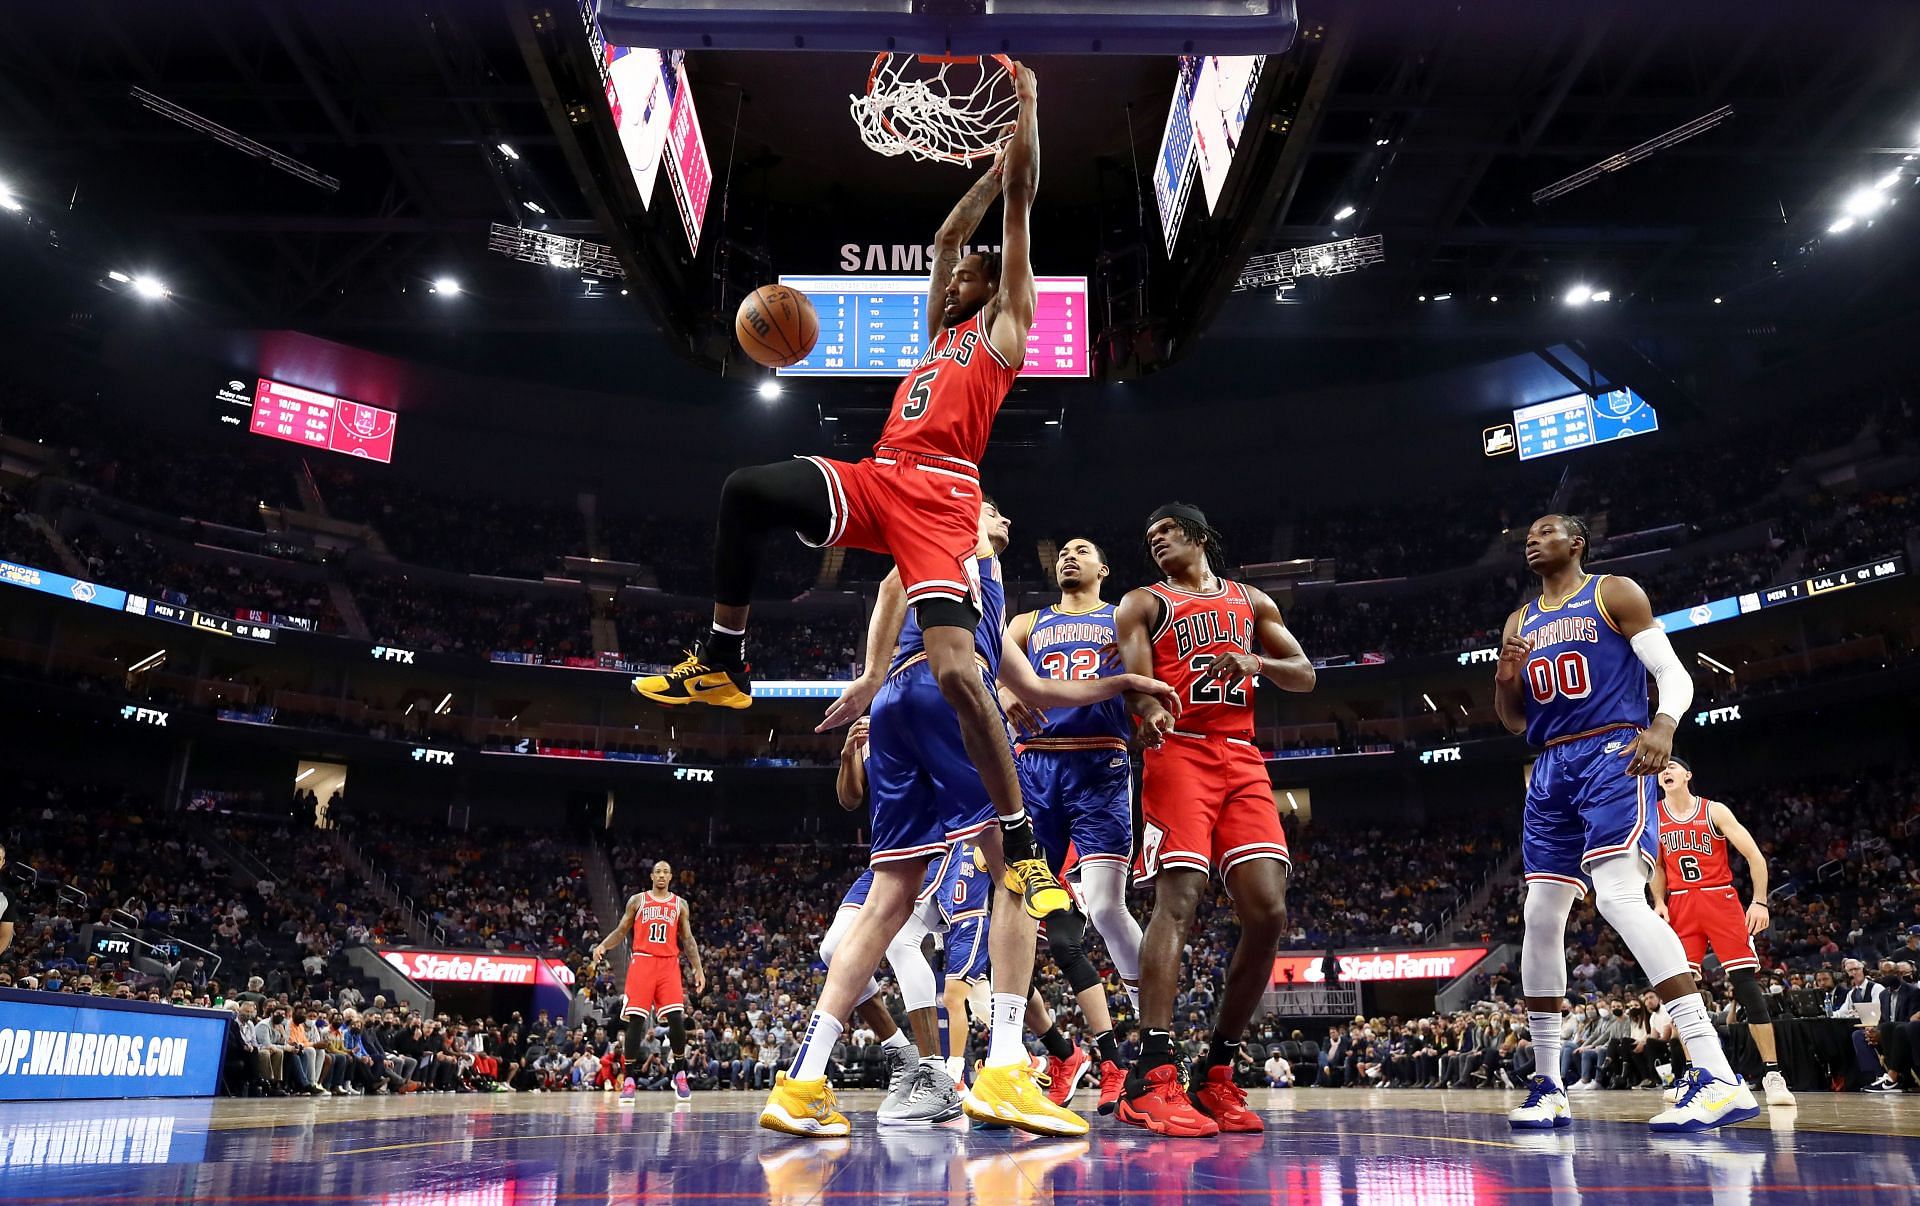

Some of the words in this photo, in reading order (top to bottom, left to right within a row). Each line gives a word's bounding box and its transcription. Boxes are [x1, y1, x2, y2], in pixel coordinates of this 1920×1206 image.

[913, 296, 919, 304] 2
[913, 309, 919, 317] 7
[1066, 309, 1072, 318] 4
[838, 321, 844, 329] 7
[910, 334, 919, 342] 12
[1063, 334, 1072, 342] 10
[901, 346, 918, 354] 47.4
[901, 368, 940, 420] 5
[1814, 578, 1834, 590] LAL
[1840, 574, 1847, 584] 4
[1857, 569, 1870, 579] Q1
[1767, 589, 1787, 602] MIN
[1791, 586, 1798, 596] 7
[155, 604, 173, 617] MIN
[179, 610, 185, 620] 7
[200, 616, 216, 627] LAL
[221, 621, 228, 631] 4
[236, 625, 248, 634] Q1
[1032, 623, 1113, 654] WARRIORS
[1173, 611, 1253, 660] BULLS
[386, 648, 414, 664] FTX
[1471, 647, 1499, 664] FTX
[1042, 648, 1100, 680] 32
[1527, 651, 1592, 704] 00
[136, 708, 168, 726] FTX
[1709, 705, 1741, 724] FTX
[426, 749, 454, 765] FTX
[1433, 747, 1461, 763] FTX
[687, 769, 714, 782] FTX
[1679, 856, 1702, 882] 6
[642, 906, 676, 926] BULLS
[649, 923, 666, 943] 11
[108, 940, 130, 953] FTX
[0, 1028, 188, 1077] OP.WARRIORS.COM
